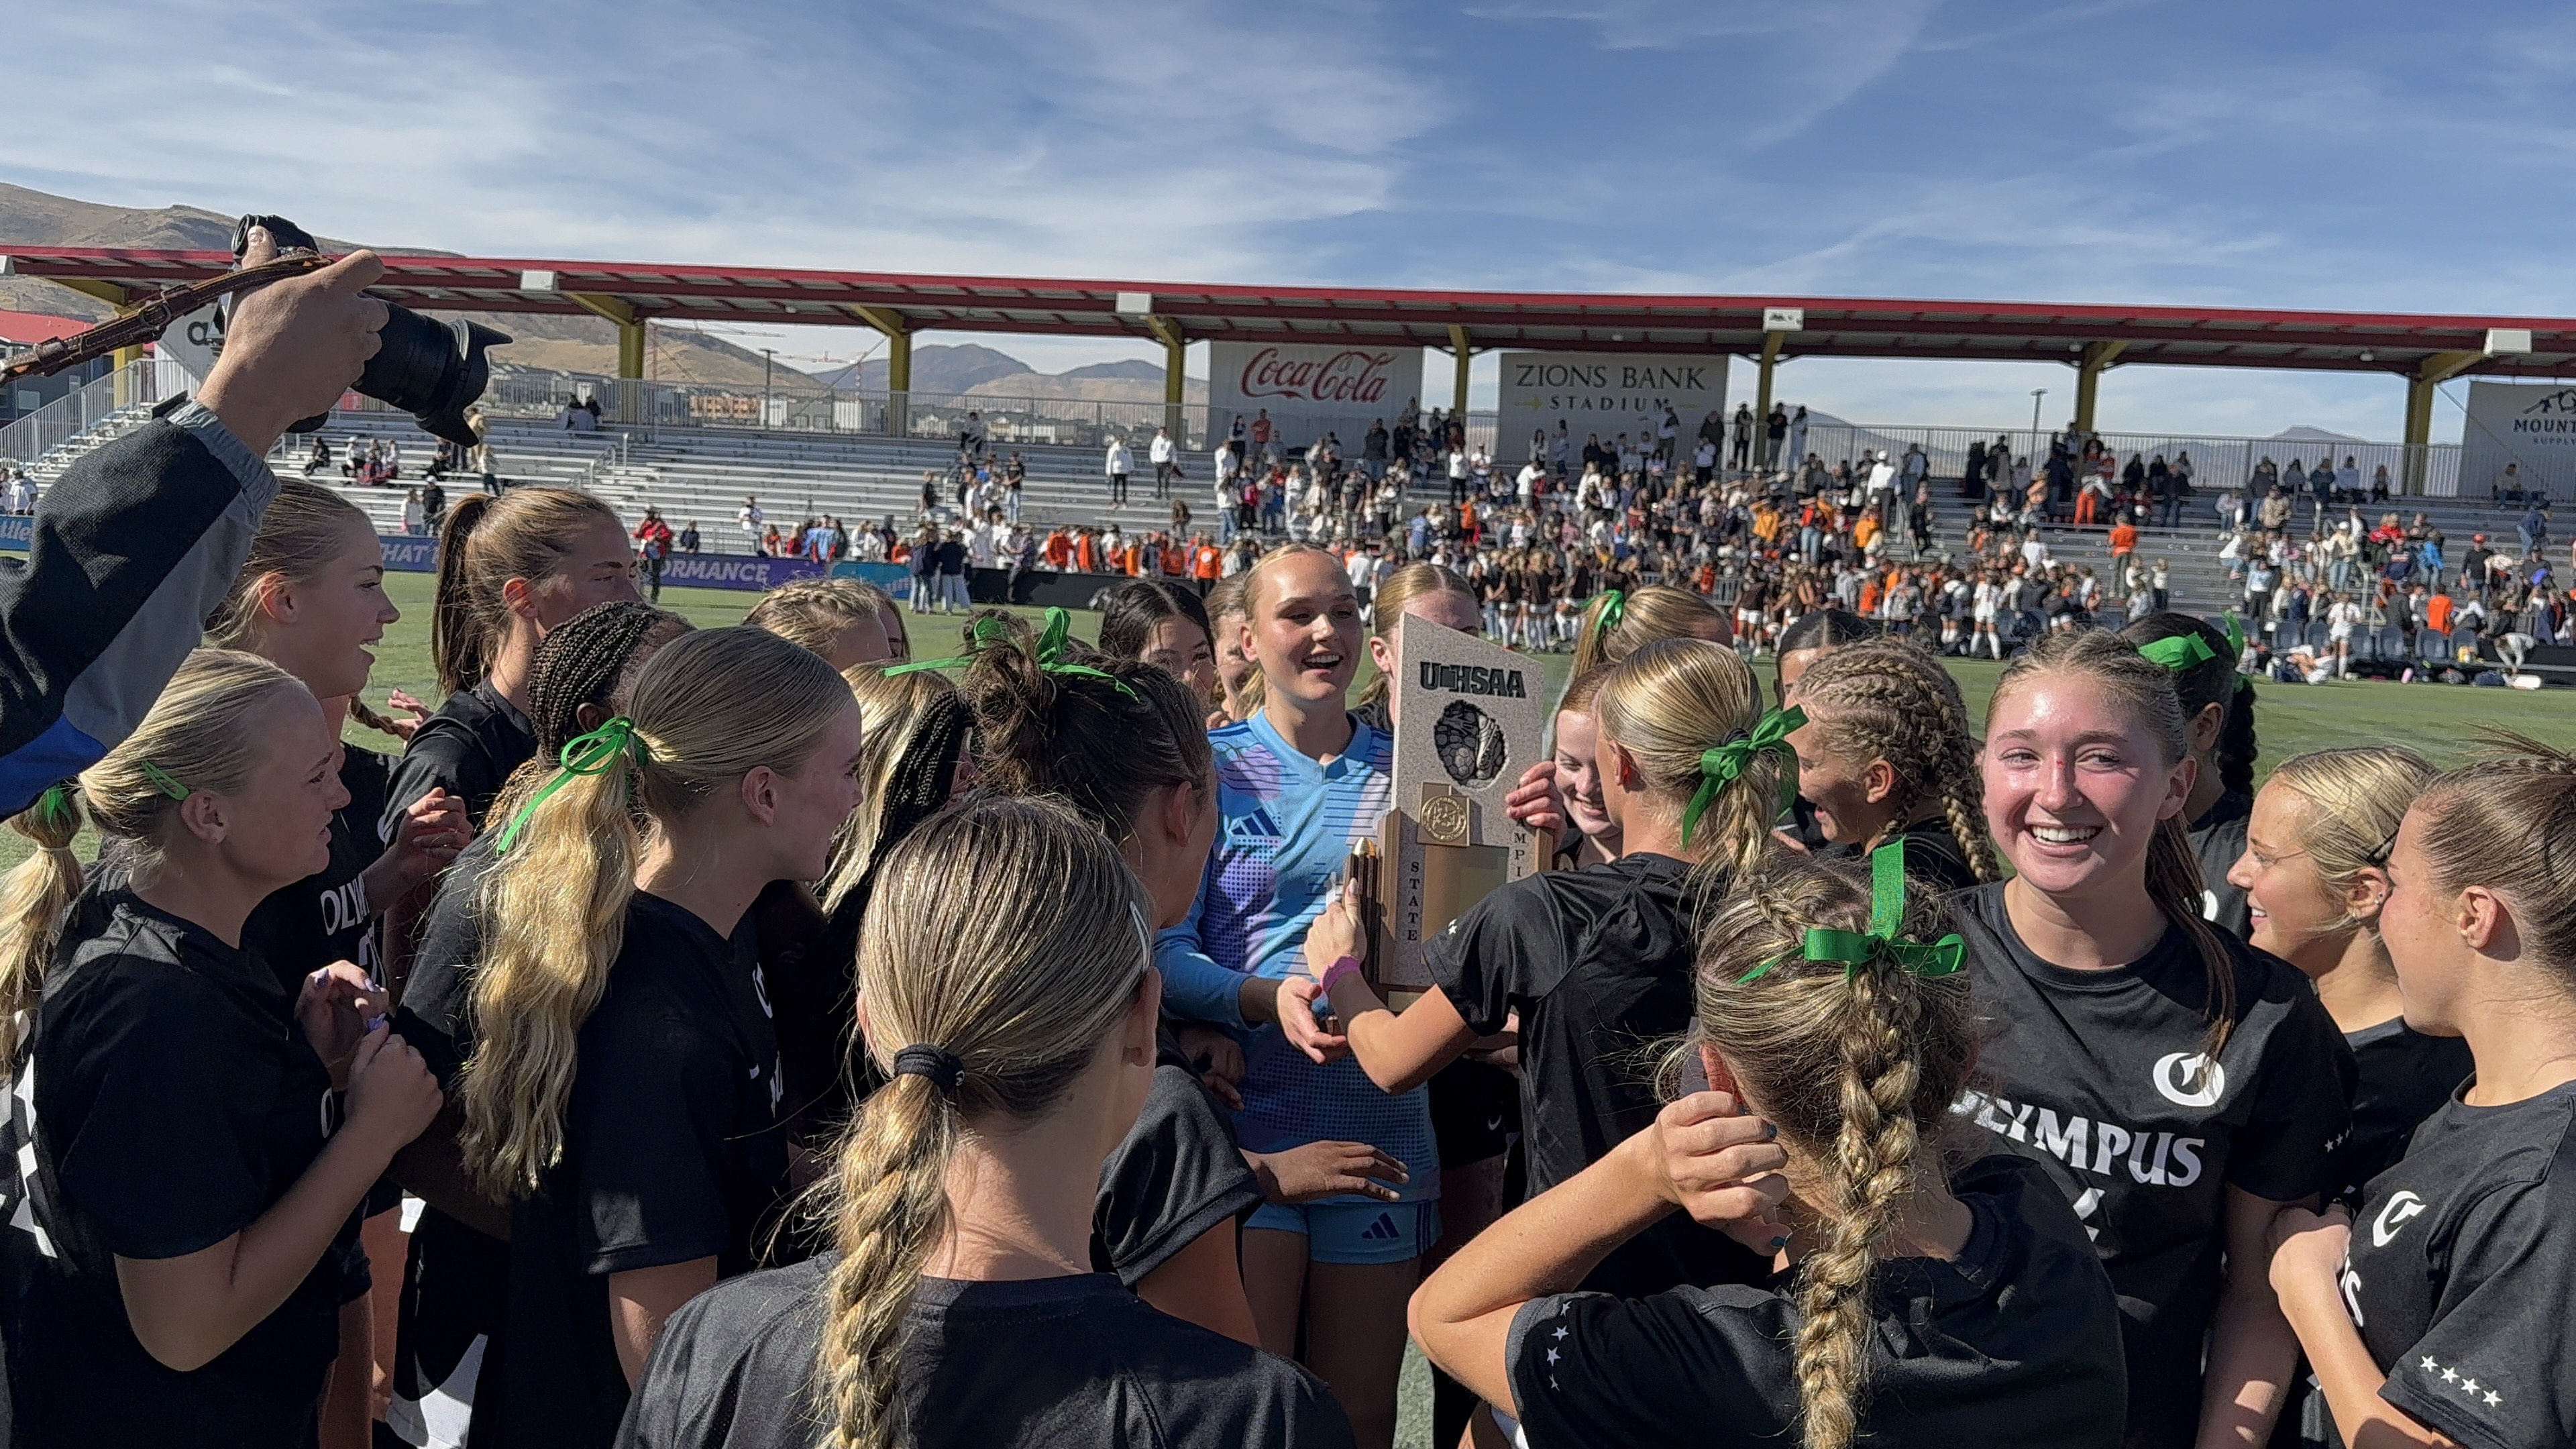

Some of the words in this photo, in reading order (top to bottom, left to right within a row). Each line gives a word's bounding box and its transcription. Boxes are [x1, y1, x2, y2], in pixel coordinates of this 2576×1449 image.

[1241, 347, 1399, 402] Coca-Cola
[1515, 364, 1608, 388] ZIONS
[1621, 366, 1709, 390] BANK
[1548, 394, 1670, 413] STADIUM
[379, 543, 429, 564] HAT
[659, 558, 771, 583] ORMANCE
[1420, 661, 1526, 698] UHSAA
[1514, 816, 1526, 877] AMPI
[320, 872, 370, 936] OLYM
[1407, 861, 1420, 941] STATE
